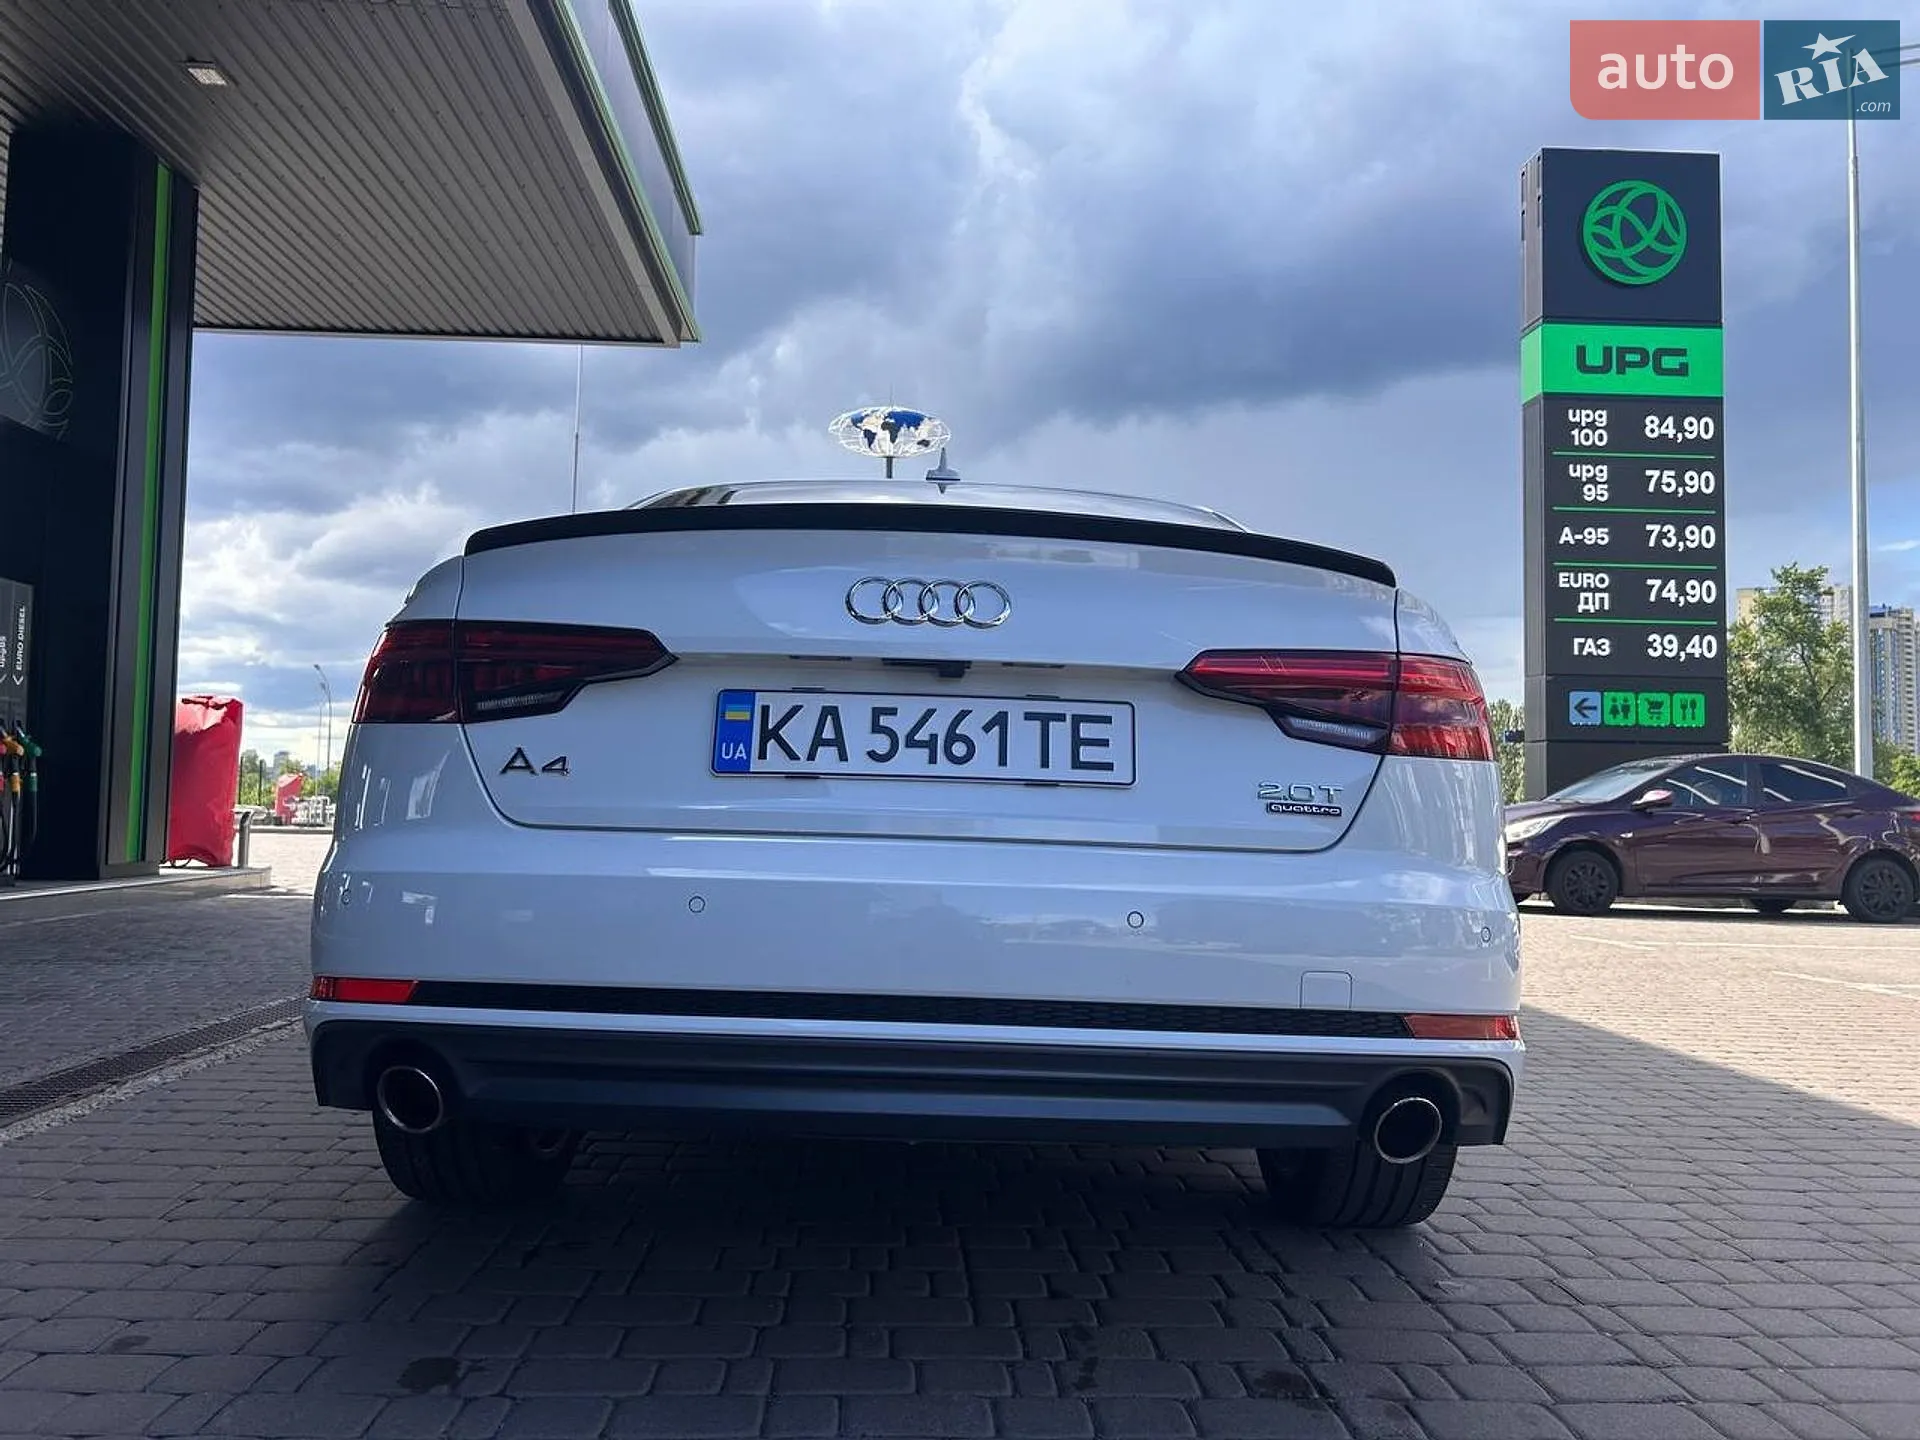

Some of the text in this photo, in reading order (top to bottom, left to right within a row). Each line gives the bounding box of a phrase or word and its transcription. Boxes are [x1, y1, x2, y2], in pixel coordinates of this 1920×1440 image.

[1576, 345, 1689, 377] UPG
[1568, 408, 1608, 427] upg
[1571, 429, 1608, 446] 100
[1644, 415, 1714, 443] 84,90
[1568, 464, 1608, 482] upg
[1645, 469, 1715, 497] 75,90
[1582, 484, 1609, 502] 95
[1559, 524, 1716, 551] A-95 73,90
[1558, 572, 1609, 588] EURO
[1577, 592, 1609, 613] ДП
[1646, 578, 1717, 607] 74,90
[1573, 633, 1718, 662] ГАЗ 39,40
[757, 704, 1115, 772] KA 5461 TE
[721, 742, 748, 761] UA
[1257, 781, 1344, 803] 2.0T
[1270, 803, 1341, 815] quattro
